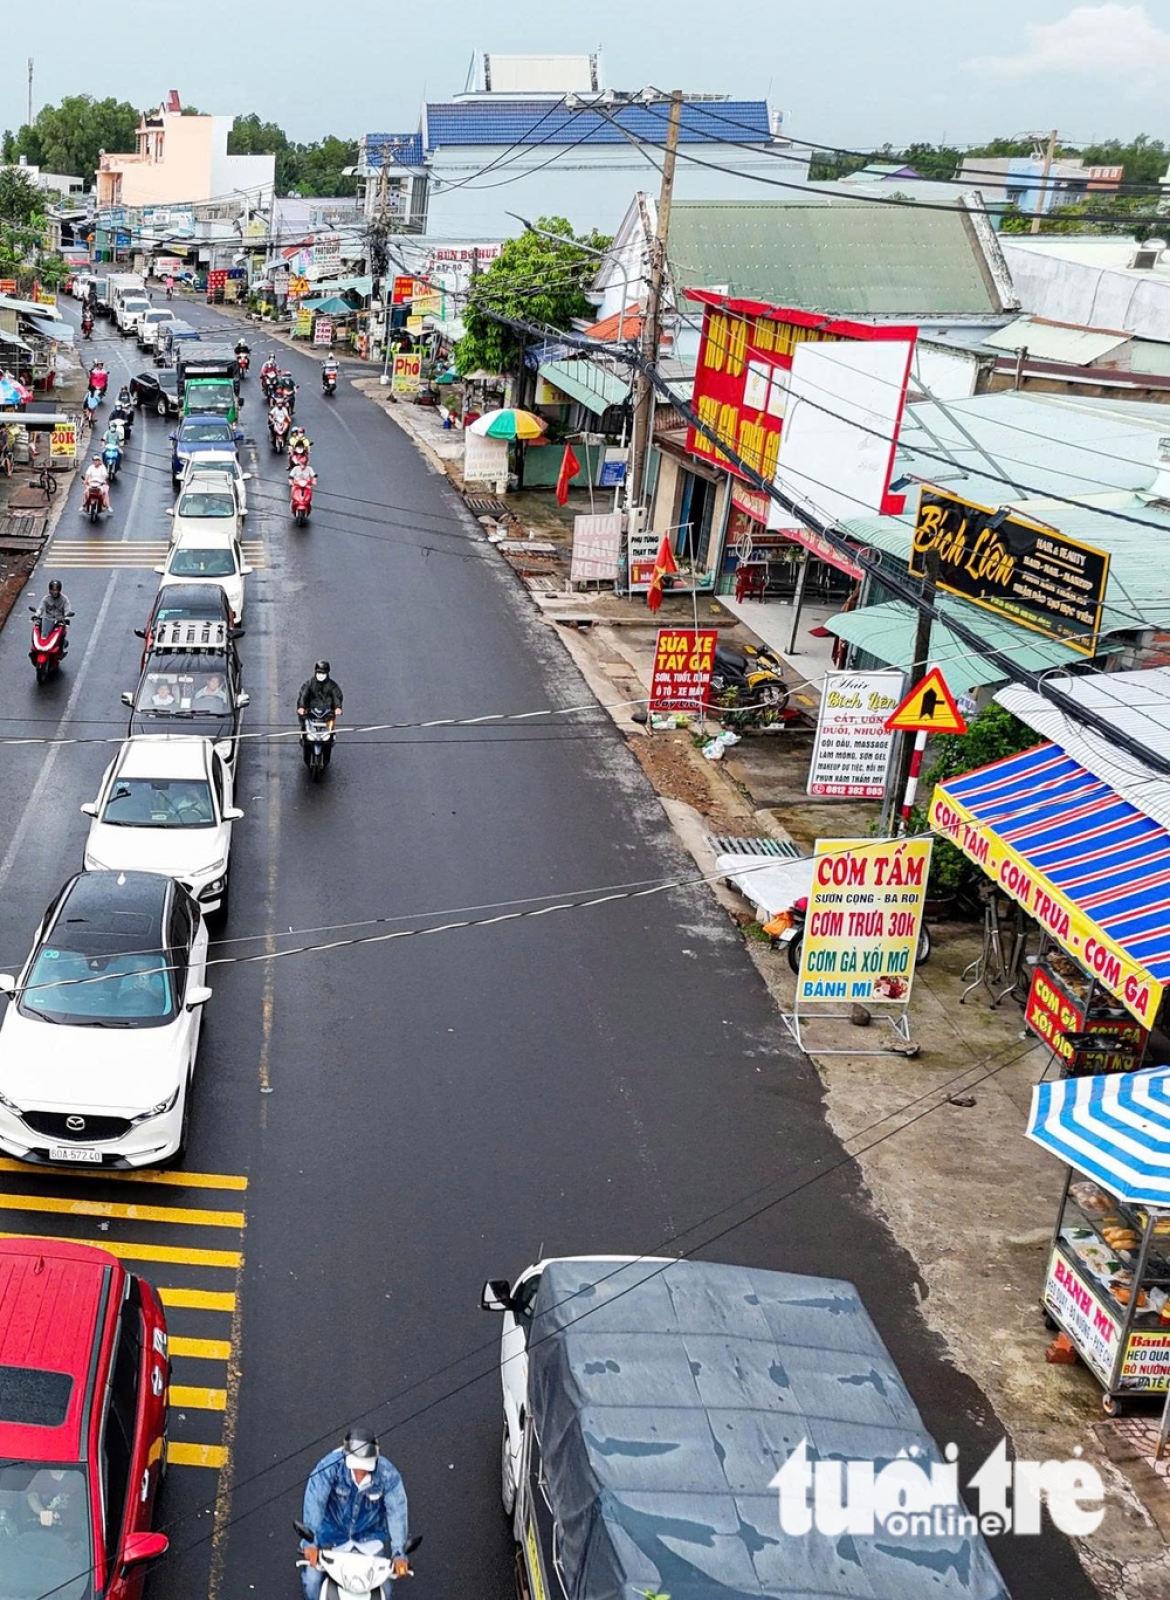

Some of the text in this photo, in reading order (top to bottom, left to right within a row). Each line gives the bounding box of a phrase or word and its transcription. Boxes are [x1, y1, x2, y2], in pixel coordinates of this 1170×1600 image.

[52, 432, 75, 444] 20K
[914, 505, 966, 567] Bích
[965, 527, 1016, 587] Liên
[658, 631, 714, 653] SỬA XE
[657, 654, 712, 671] TAY GA
[854, 741, 889, 749] MASSAGE
[818, 843, 925, 886] CƠM TẤM
[815, 893, 919, 905] SƯỜN CỌNG BA RỌI
[811, 910, 844, 937] CƠM
[848, 910, 884, 937] TRƯA
[1000, 859, 1033, 902] CƠM
[1033, 887, 1071, 941] TRƯA
[1084, 937, 1122, 988] CƠM
[807, 943, 910, 972] CƠM GÀ XỐI MỠ
[803, 979, 847, 997] BÁNH
[1034, 978, 1061, 1017] CƠM
[1053, 1258, 1094, 1320] BÁNH
[1127, 1350, 1147, 1361] HEO
[1123, 1363, 1137, 1375] BÒ
